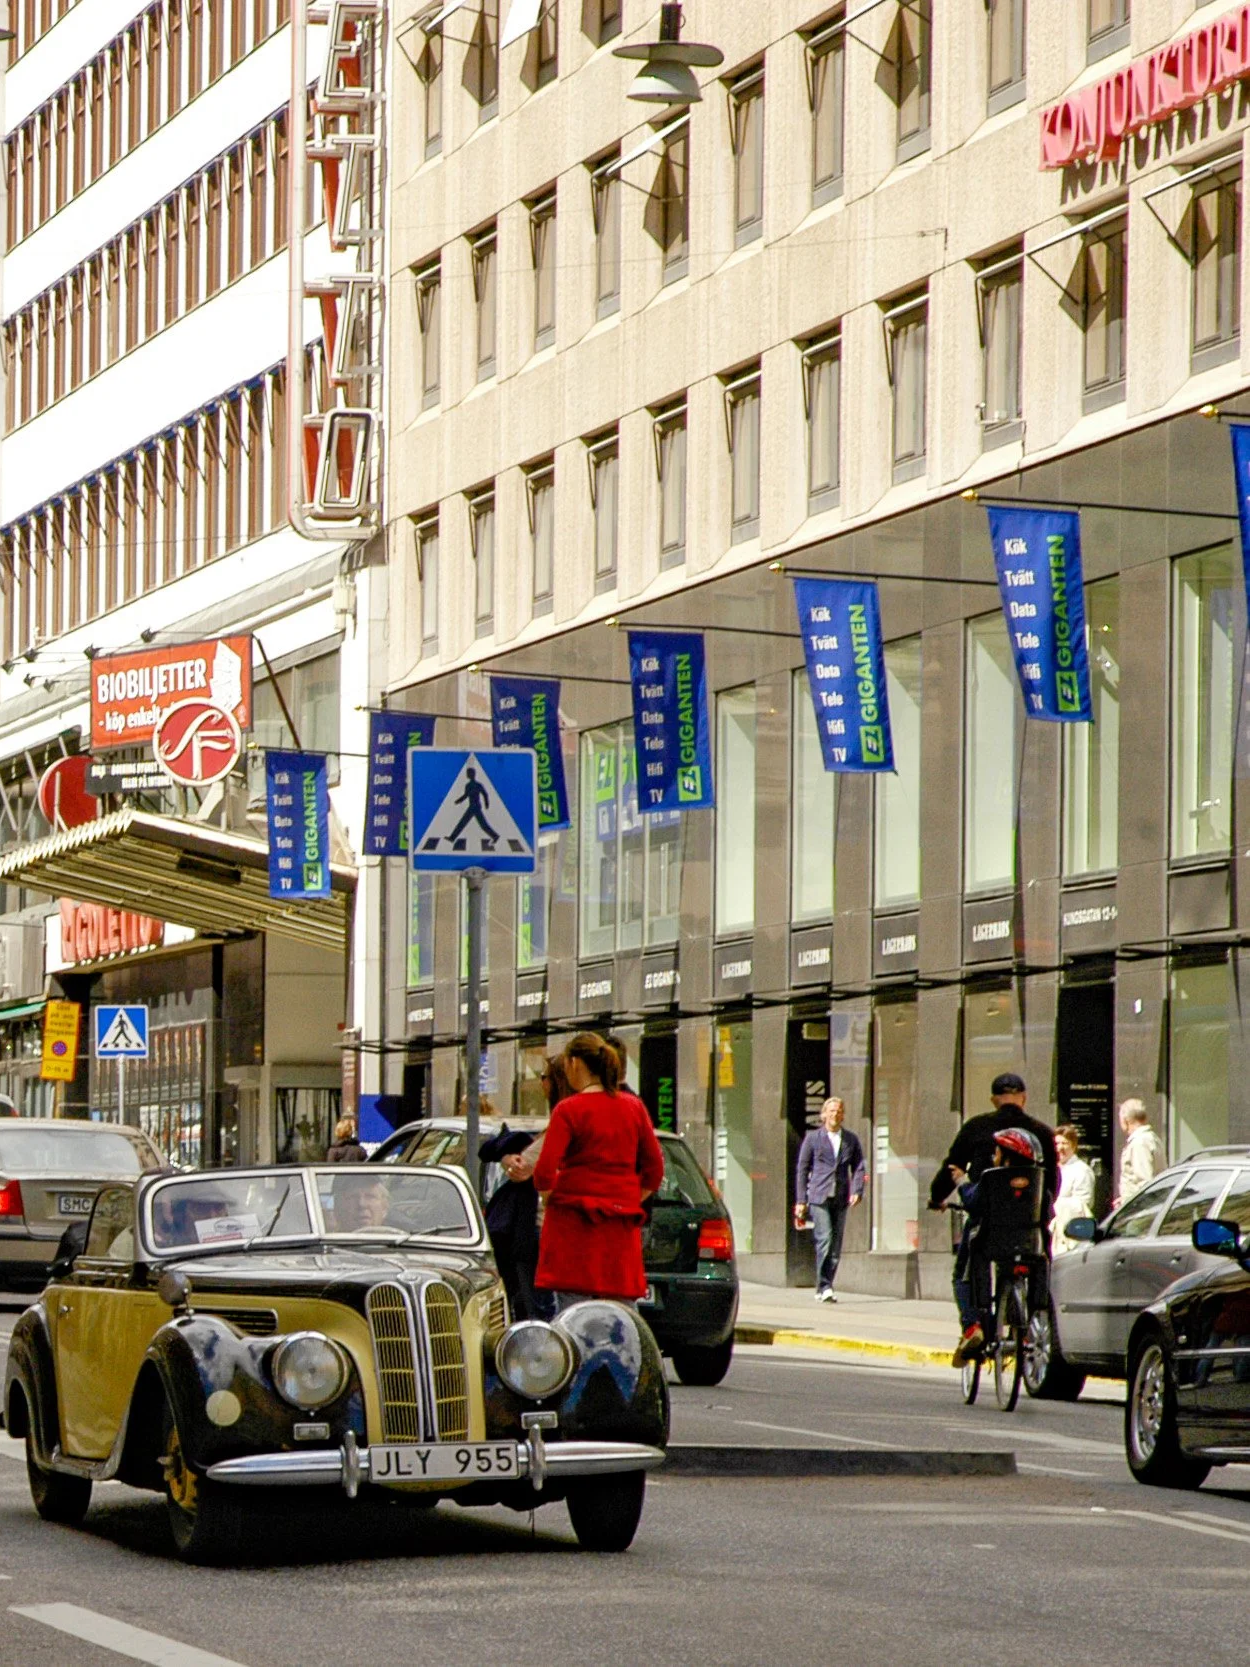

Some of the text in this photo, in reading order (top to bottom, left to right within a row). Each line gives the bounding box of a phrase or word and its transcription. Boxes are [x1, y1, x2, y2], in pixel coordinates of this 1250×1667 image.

[1004, 537, 1027, 555] Kök
[1004, 569, 1035, 587] Tvätt
[1046, 534, 1073, 667] GIGANTEN
[811, 606, 831, 622] Kök
[1010, 602, 1037, 617] Data
[811, 635, 838, 651] Tvätt
[1015, 631, 1040, 649] Tele
[641, 656, 660, 673] Kök
[848, 604, 878, 723] GIGANTEN
[816, 664, 840, 679] Data
[97, 658, 208, 703] BIOBILJETTER
[639, 684, 664, 699] Tvätt
[820, 691, 843, 707] Tele
[500, 696, 517, 710] Kök
[676, 653, 696, 765] GIGANTEN
[105, 710, 126, 735] köp
[642, 711, 664, 726] Data
[498, 720, 521, 734] Tvätt
[827, 719, 845, 735] Hifi
[531, 693, 553, 791] GIGANTEN
[643, 736, 665, 751] Tele
[375, 754, 395, 765] Tvätt
[833, 747, 847, 762] TV
[646, 762, 664, 777] Hifi
[374, 774, 393, 785] Data
[273, 794, 293, 806] Tvätt
[374, 794, 391, 806] Tele
[649, 789, 664, 804] TV
[274, 815, 293, 828] Data
[303, 771, 320, 860] GIGANTEN
[276, 837, 293, 849] Tele
[375, 837, 387, 848] TV
[280, 877, 292, 890] TV
[64, 1198, 90, 1211] SMC
[376, 1447, 512, 1477] JLY 955
